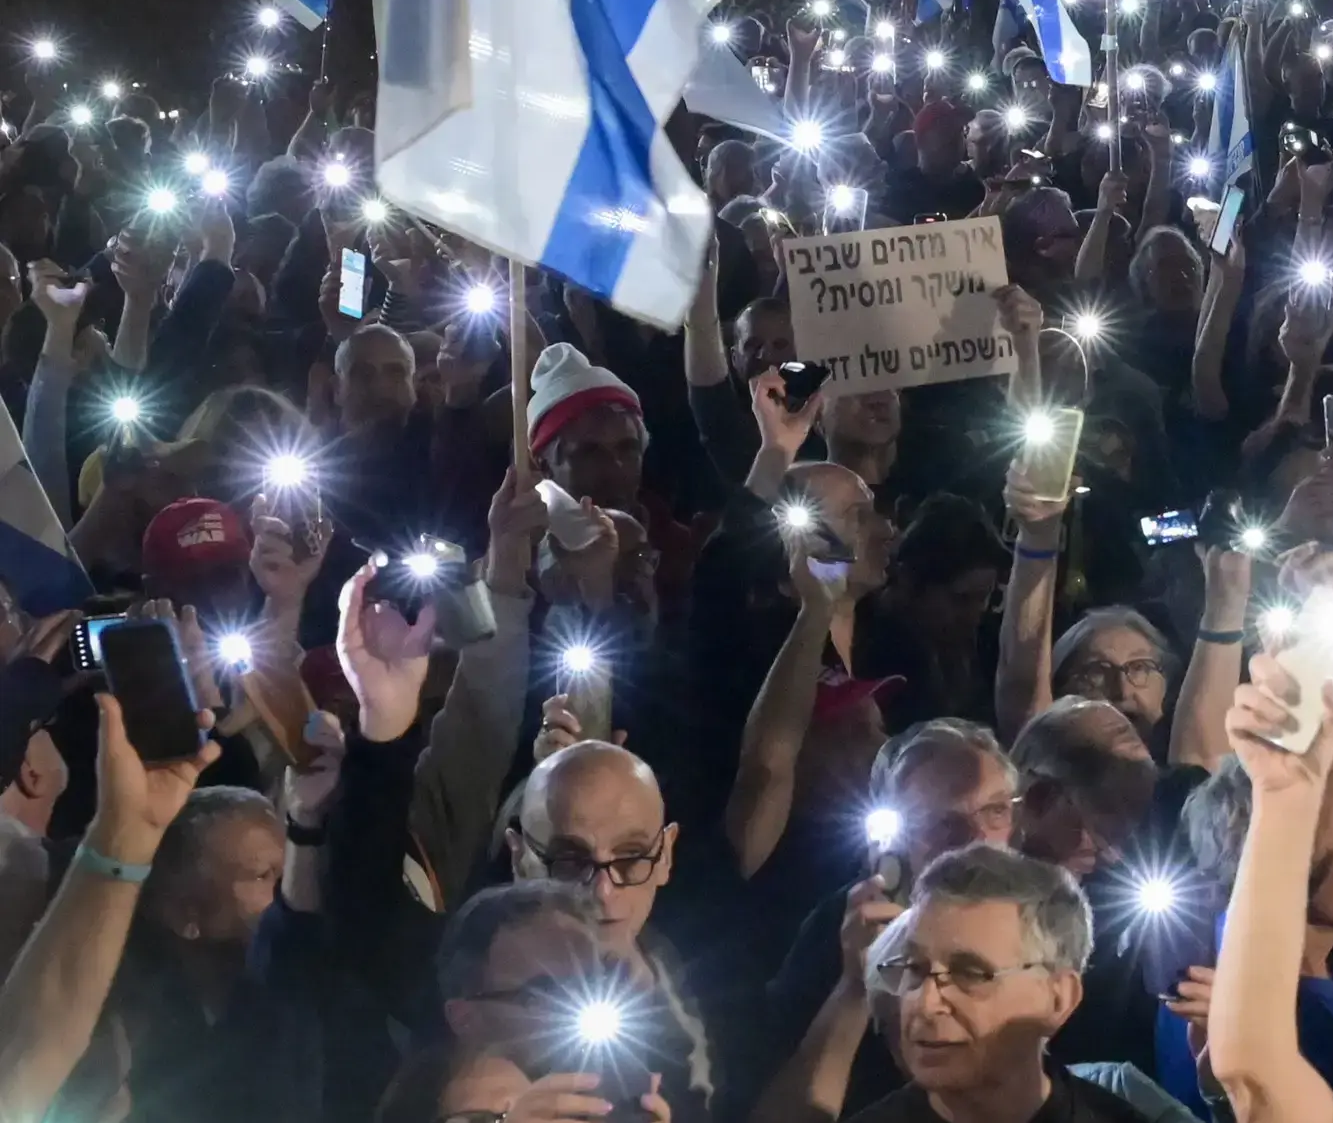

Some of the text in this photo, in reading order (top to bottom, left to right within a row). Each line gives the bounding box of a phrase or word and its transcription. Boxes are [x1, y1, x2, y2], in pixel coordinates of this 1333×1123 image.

[788, 225, 998, 274] איך מזהים שביבי
[810, 270, 986, 314] משקר ומסית?
[859, 344, 900, 378] שלו
[909, 334, 1014, 371] השפתיים
